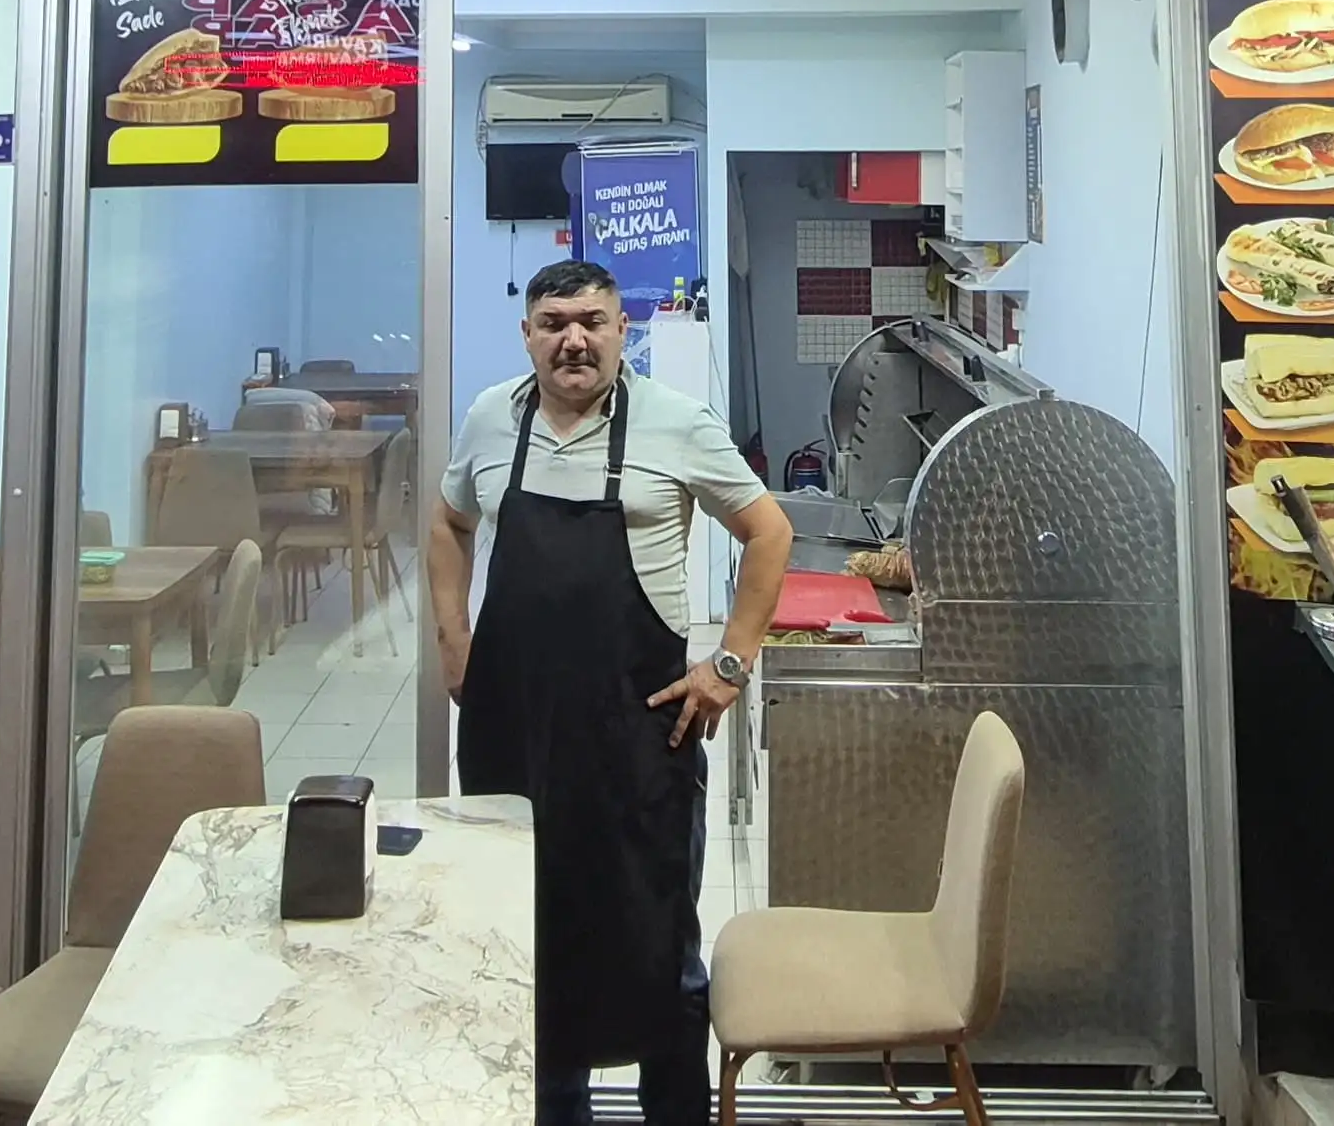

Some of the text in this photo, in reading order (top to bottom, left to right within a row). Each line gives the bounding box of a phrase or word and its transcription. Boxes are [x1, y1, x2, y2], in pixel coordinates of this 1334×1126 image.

[116, 5, 164, 39] Sade
[634, 179, 667, 195] OLMAK
[610, 201, 625, 214] EN
[595, 208, 677, 246] ÇALKALA
